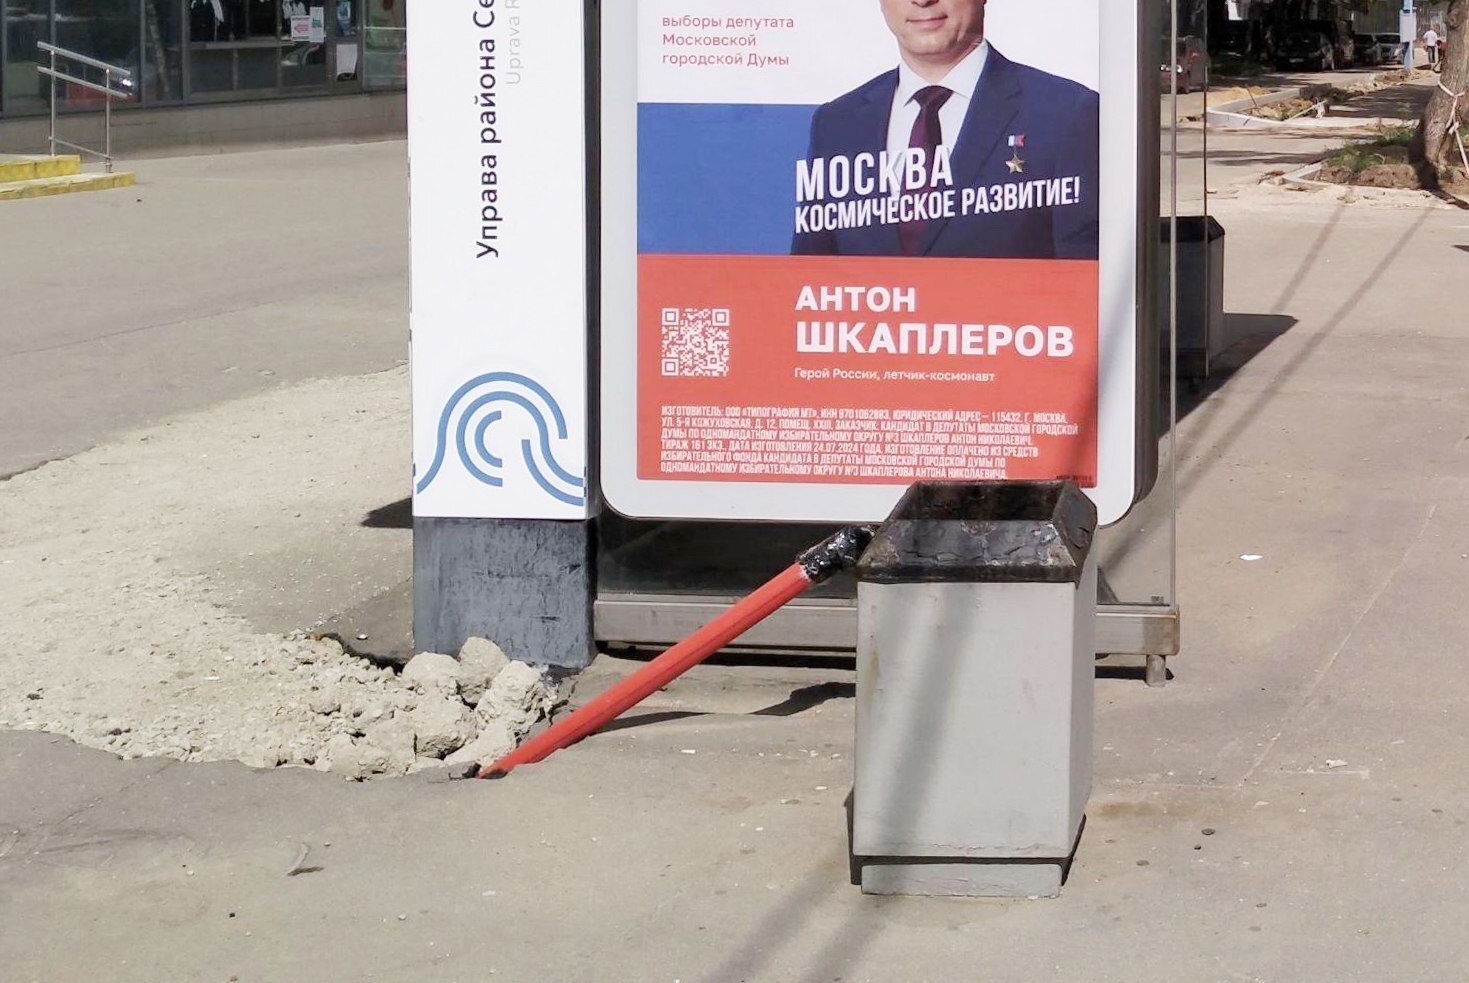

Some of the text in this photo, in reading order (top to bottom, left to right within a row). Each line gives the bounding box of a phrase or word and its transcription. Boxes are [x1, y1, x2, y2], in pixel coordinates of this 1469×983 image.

[662, 14, 794, 30] выборы депутата
[662, 33, 756, 47] Московской
[505, 15, 523, 85] Uprava
[662, 52, 789, 68] городской Думы
[474, 38, 502, 144] района
[795, 144, 953, 202] МОСКВА
[475, 154, 503, 259] Управа
[795, 176, 1080, 234] КОСМИЧЕСКОЕ РАЗВИТИЕ!
[795, 286, 916, 313] АНТОН
[796, 320, 1075, 357] ШКАПЛЕРОВ
[794, 367, 995, 382] Герой России, летчик-космонавт
[821, 408, 837, 418] ИНН
[955, 411, 981, 422] АДРЕС
[662, 429, 686, 439] ДУМЫ
[688, 429, 699, 438] ПО
[701, 429, 777, 440] ОДНОМАНДАТНОМУ
[779, 430, 851, 441] ИЗБИРАТЕЛЬНОМУ
[853, 432, 884, 442] ОКРУГУ
[900, 433, 949, 443] ШКАПЛЕРОВ
[951, 434, 976, 444] АНТОН
[881, 421, 924, 431] КАНДИДАТ
[932, 422, 976, 432] ДЕПУТАТЫ
[977, 423, 1030, 434] МОСКОВСКОЙ
[1032, 424, 1078, 435] ГОРОДСКОЙ
[662, 440, 688, 449] ТИРАЖ
[729, 441, 750, 451] ДАТА
[752, 441, 812, 452] ИЗГОТОВЛЕНИЯ
[885, 444, 945, 455] ИЗГОТОВЛЕНИЕ
[947, 446, 989, 456] ОПЛАЧЕНО
[991, 446, 1001, 456] ИЗ
[1003, 447, 1038, 457] СРЕДСТВ
[661, 451, 731, 461] ИЗБИРАТЕЛЬНОГО
[733, 452, 762, 462] ФОНДА
[764, 453, 812, 464] КАНДИДАТА
[820, 454, 863, 464] ДЕПУТАТЫ
[865, 455, 917, 466] МОСКОВСКОЙ
[919, 456, 966, 466] ГОРОДСКОЙ
[968, 457, 992, 468] ДУМЫ
[994, 458, 1005, 467] ПО
[661, 462, 738, 473] ОДНОМАНДАТНОМУ
[739, 464, 812, 474] ИЗБИРАТЕЛЬНОМУ
[814, 465, 844, 475] ОКРУГУ
[860, 466, 914, 477] ШКАПЛЕРОВА
[916, 467, 946, 478] АНТОНА
